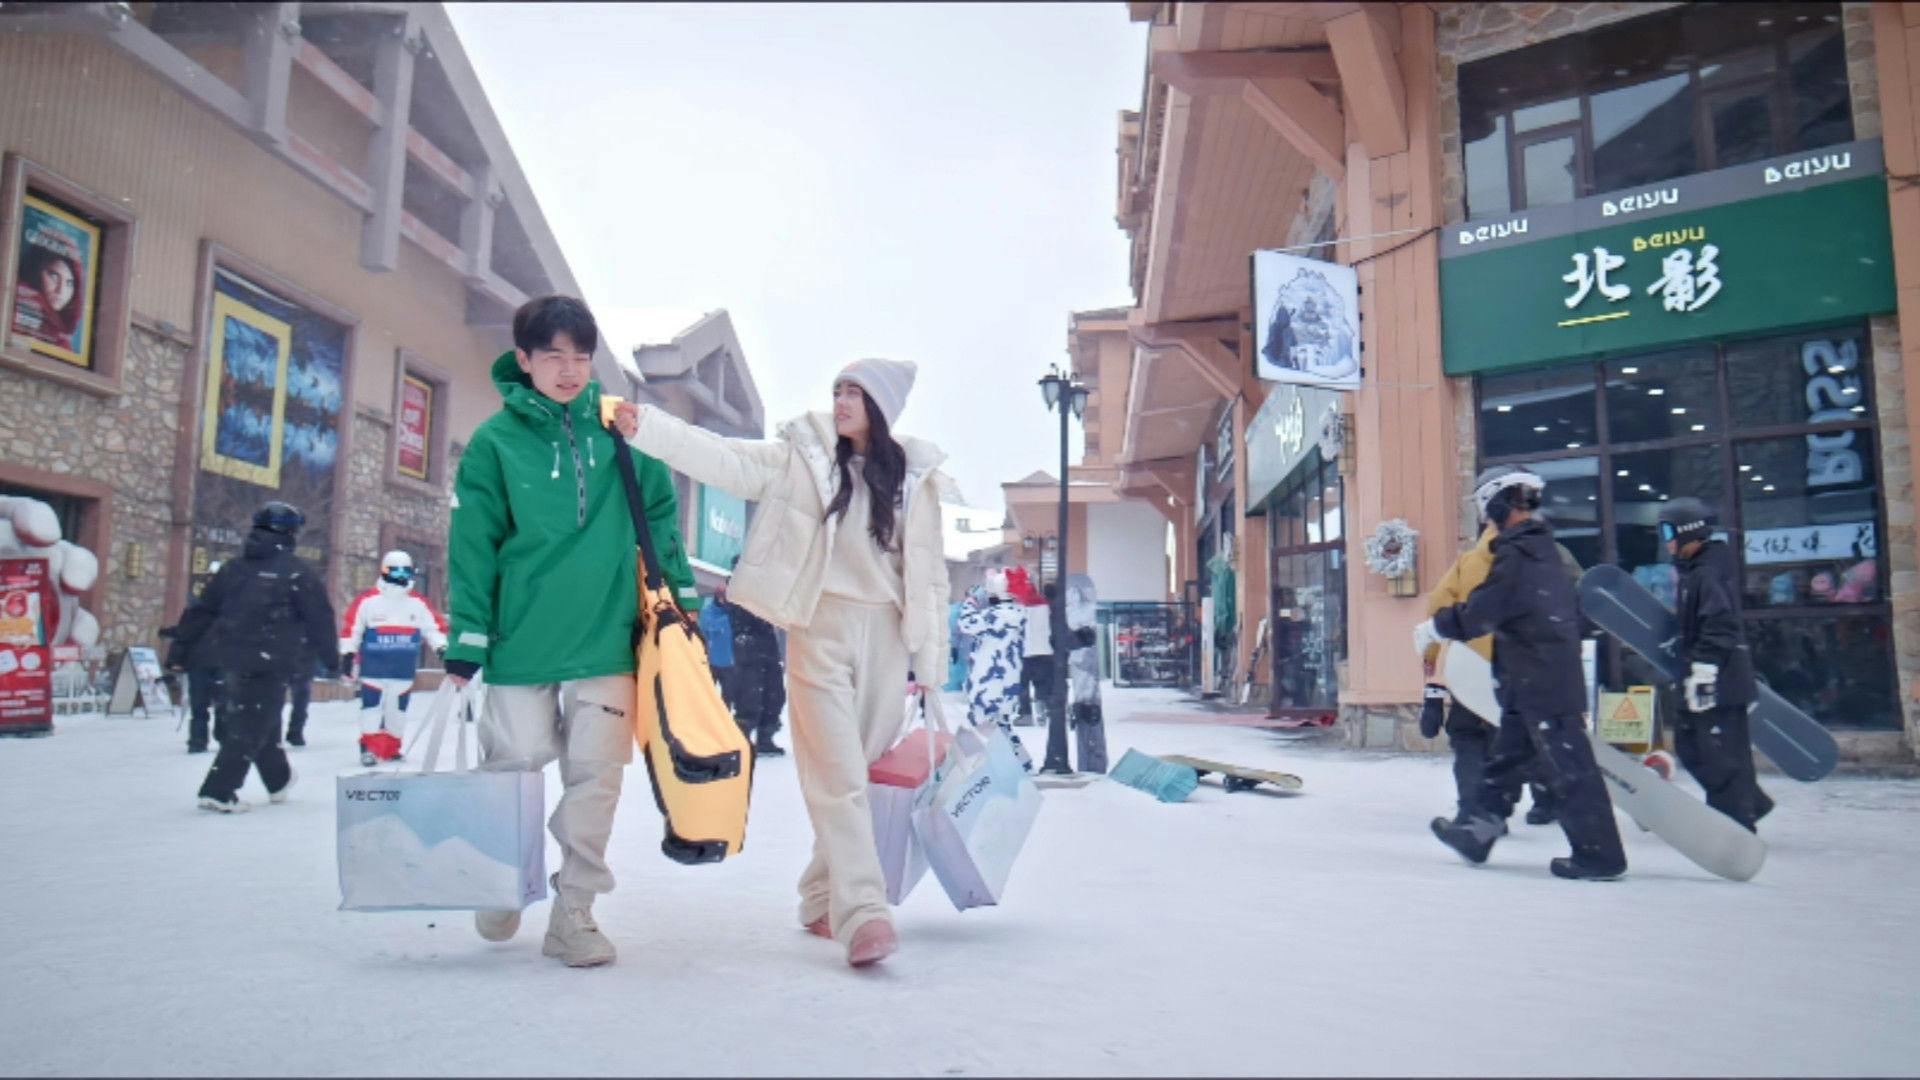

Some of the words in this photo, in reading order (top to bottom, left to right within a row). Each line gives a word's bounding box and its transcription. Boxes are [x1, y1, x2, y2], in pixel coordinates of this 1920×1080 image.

[1562, 244, 1722, 312] 北影
[345, 789, 402, 801] VECTOR
[951, 775, 991, 818] VECTOR
